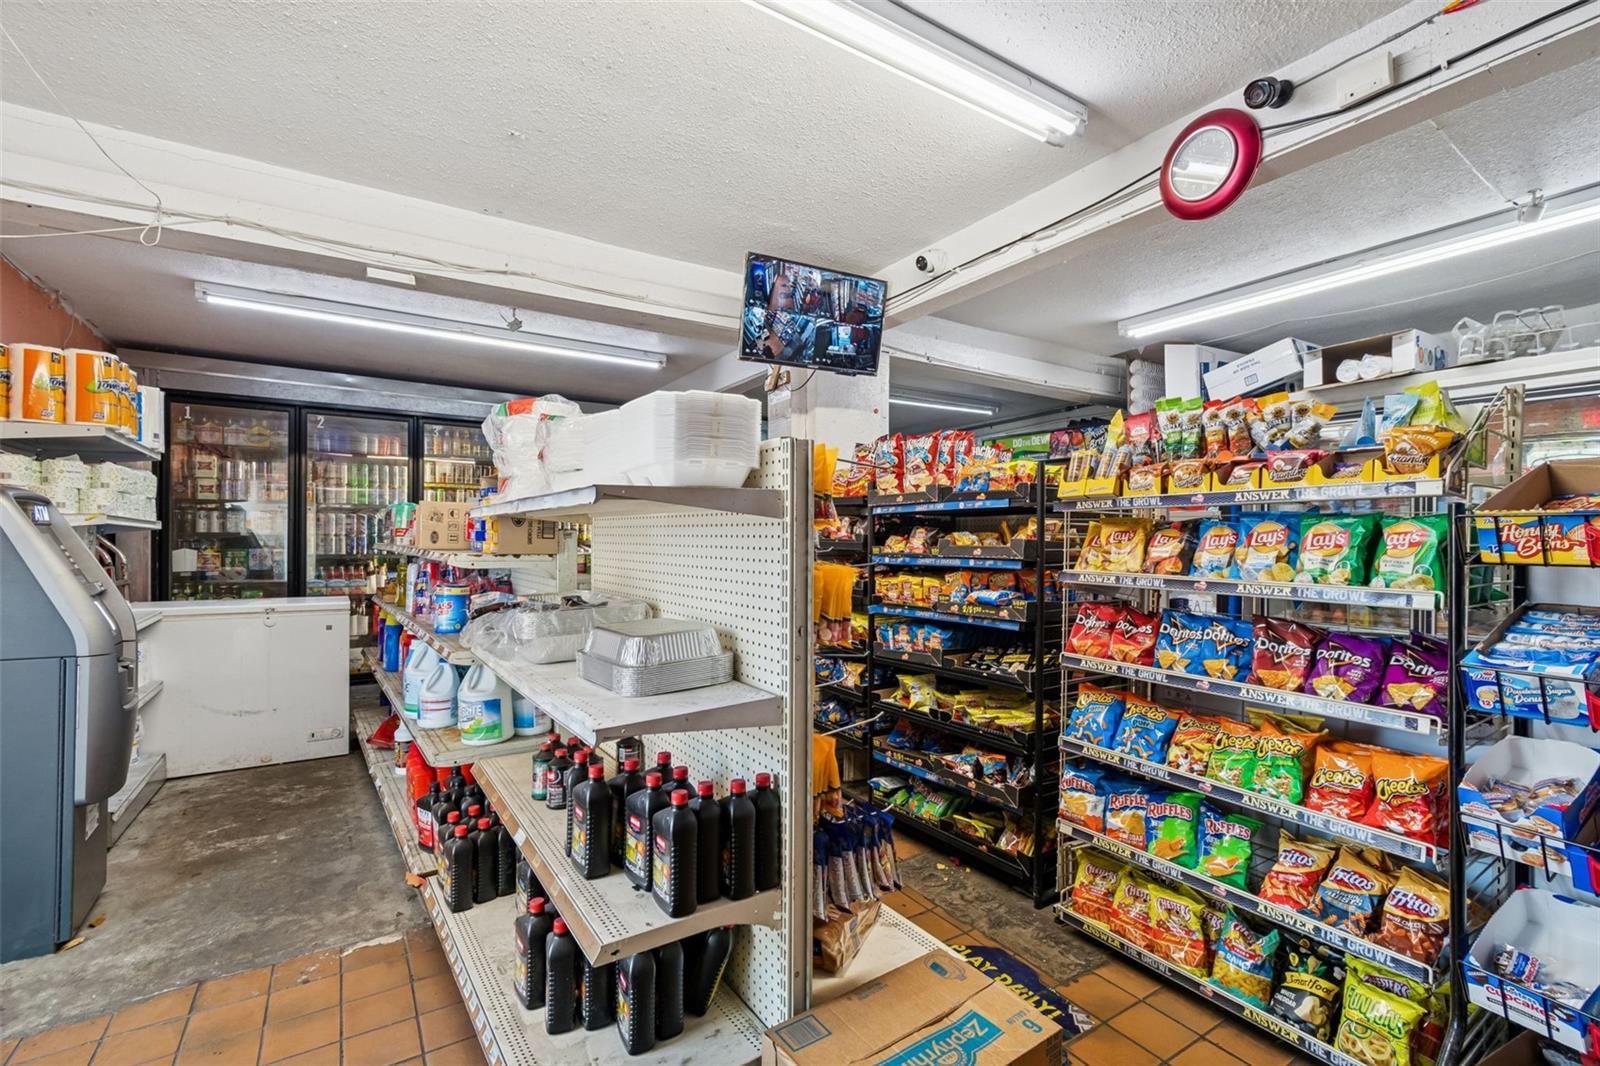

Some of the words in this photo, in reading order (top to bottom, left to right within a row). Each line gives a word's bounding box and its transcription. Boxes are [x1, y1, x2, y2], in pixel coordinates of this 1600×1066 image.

[184, 405, 192, 420] 1
[316, 415, 325, 429] 2
[433, 426, 440, 437] 3
[1013, 439, 1023, 448] DO
[1076, 500, 1113, 510] ANSWER
[1116, 499, 1131, 508] THE
[1132, 497, 1162, 507] GROWL
[1235, 490, 1290, 502] ANSWER
[1294, 488, 1315, 499] THE
[1320, 485, 1364, 497] GROWL
[34, 505, 50, 521] ATM
[1109, 529, 1136, 544] Lay's
[1204, 532, 1239, 550] Lay's
[1250, 528, 1286, 547] Lay's
[1306, 531, 1348, 550] Lay's
[1078, 574, 1116, 584] ANSWER
[1119, 577, 1133, 586] THE
[1136, 577, 1166, 588] GROWL
[1236, 584, 1292, 596] ANSWER
[1296, 586, 1318, 598] THE
[1322, 588, 1369, 601] GROWL
[1115, 619, 1153, 635] Doritos
[1160, 623, 1203, 640] Doritos
[1203, 628, 1251, 648] Doritos
[1255, 636, 1312, 656] Doritos
[1316, 648, 1373, 668] Doritos
[1080, 658, 1118, 674] ANSWER
[1121, 666, 1136, 677] THE
[1138, 668, 1168, 682] GROWL
[1123, 703, 1168, 724] Cheetos
[1239, 688, 1296, 706] ANSWER
[1327, 703, 1373, 721] GROWL
[1214, 733, 1258, 751] Cheetos
[1256, 736, 1304, 760] Cheetos
[1082, 747, 1121, 765] ANSWER
[1122, 759, 1139, 770] THE
[1140, 762, 1171, 780] GROWL
[1310, 768, 1365, 789] Cheetos
[1376, 777, 1429, 802] Cheetos
[1148, 802, 1193, 821] RUFFLES
[1241, 795, 1299, 821] ANSWER
[1302, 813, 1327, 830] THE
[1329, 820, 1379, 844] GROWL
[1204, 819, 1251, 841] RUFFLES
[1092, 837, 1132, 860] ANSWER
[1134, 854, 1150, 867] THE
[1151, 859, 1184, 880] GROWL
[1327, 865, 1377, 894] Fritos
[1387, 888, 1440, 918] Fritos
[1257, 902, 1316, 935] ANSWER
[1319, 928, 1343, 946] THE
[1346, 938, 1398, 968] GROWL
[1082, 922, 1121, 950] ANSWER
[1123, 944, 1140, 960] THE
[1141, 952, 1172, 976] GROWL
[1286, 973, 1336, 995] Smartfood
[1242, 1007, 1300, 1045] ANSWER
[1304, 1039, 1328, 1060] THE
